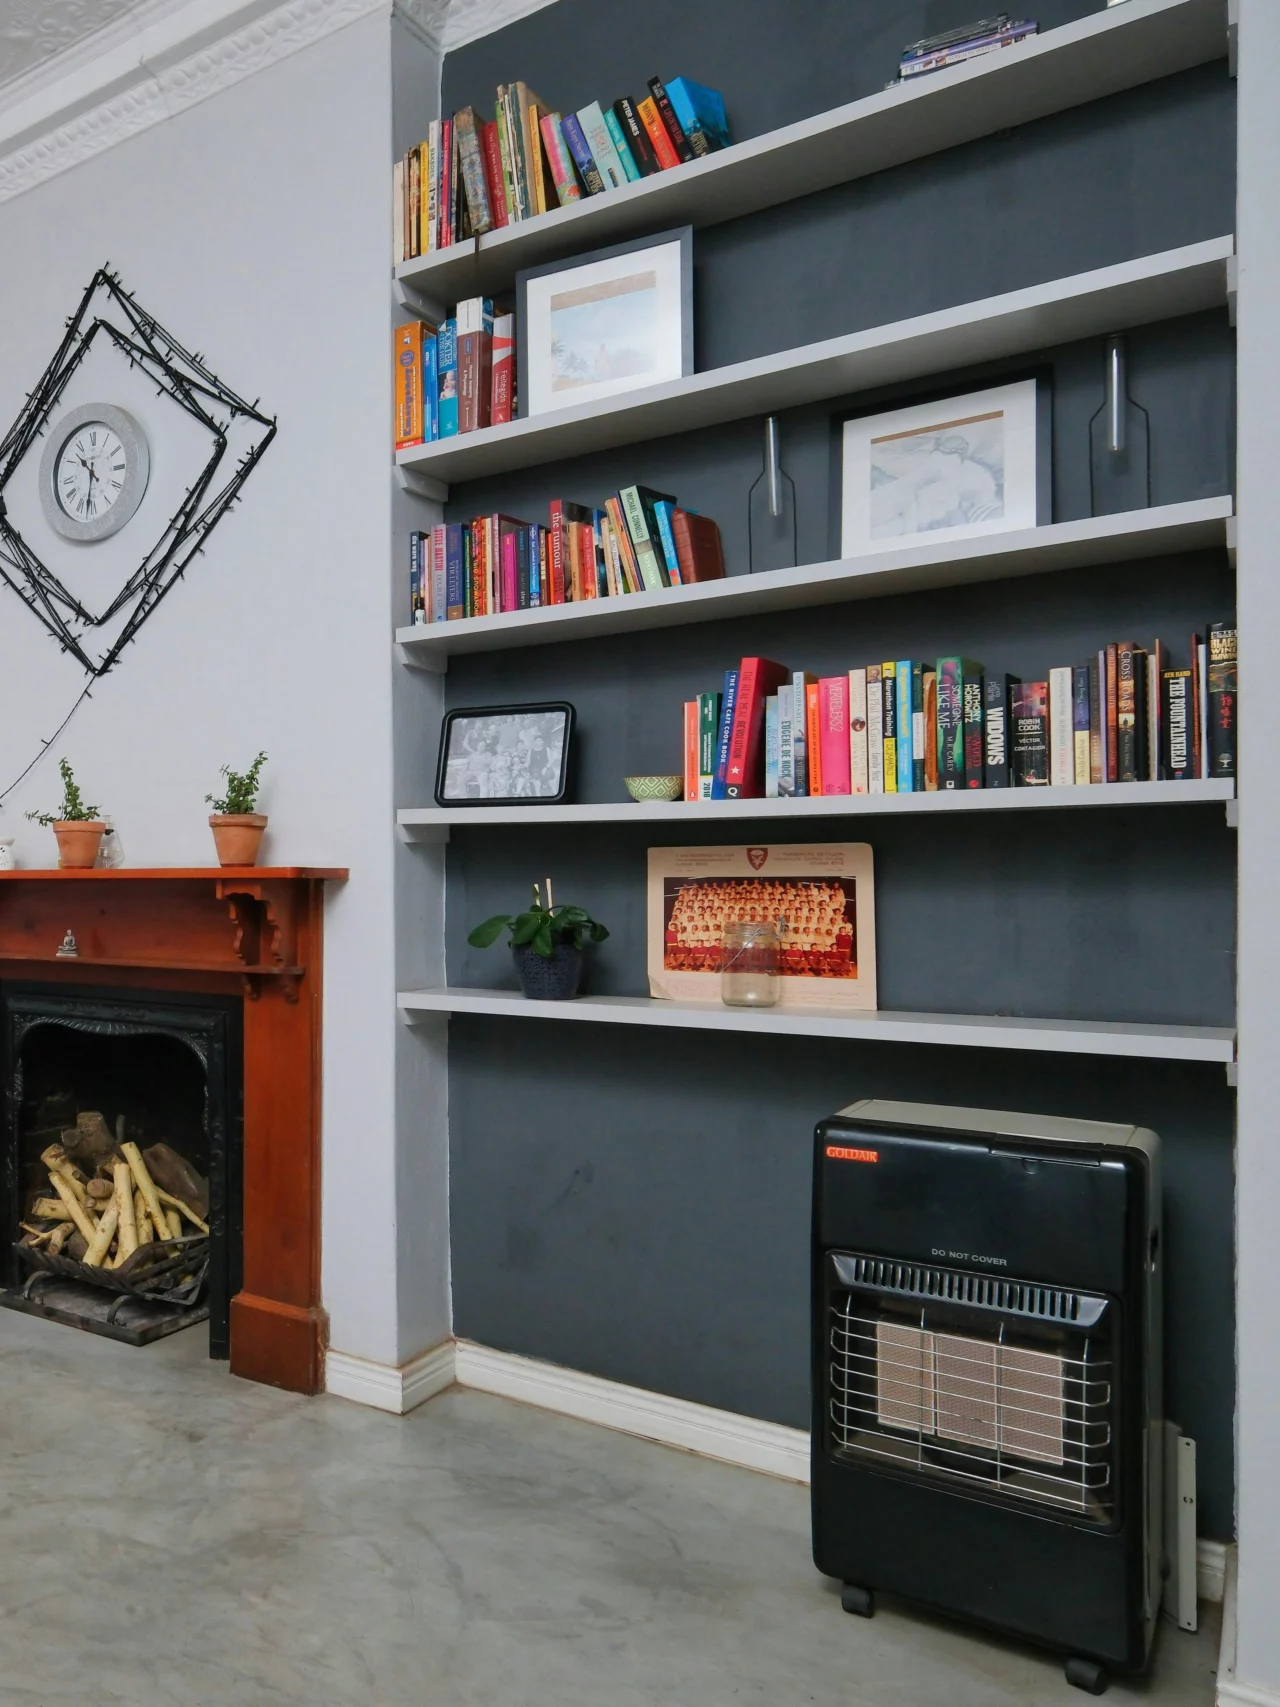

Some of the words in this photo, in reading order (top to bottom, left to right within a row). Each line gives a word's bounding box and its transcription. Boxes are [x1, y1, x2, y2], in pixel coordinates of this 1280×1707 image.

[621, 99, 632, 118] PETER
[627, 116, 639, 136] JAMES
[499, 370, 507, 403] Feitegids
[404, 368, 412, 436] Emergency
[553, 512, 561, 528] the
[625, 491, 636, 514] MICHAEL
[631, 514, 643, 539] CONNELLY
[435, 529, 443, 547] STEVE
[435, 548, 443, 570] MARTINI
[1121, 651, 1131, 679] CROSS
[742, 671, 753, 682] THE
[740, 684, 751, 701] REAL
[870, 686, 878, 696] Dr
[885, 680, 893, 710] Marathon
[938, 684, 949, 708] LIKE
[1122, 681, 1131, 711] ROADS
[1169, 678, 1185, 697] THE
[726, 688, 735, 708] RIVER
[870, 698, 880, 713] Phil
[952, 685, 960, 726] SOMEONE
[973, 684, 981, 722] ANTHONY
[724, 709, 732, 724] CAFE
[737, 702, 748, 721] MEAL
[938, 712, 949, 729] ME
[870, 716, 880, 749] McGraw
[885, 711, 893, 736] Training
[1170, 698, 1186, 768] FOUNTAINHEAD
[722, 726, 730, 743] COOK
[732, 720, 747, 759] REVOLUTION
[781, 721, 791, 747] EUGENE
[987, 707, 1004, 765] WIDOWS
[719, 745, 728, 764] BOOK
[782, 750, 791, 758] DE
[871, 752, 880, 769] family
[782, 760, 791, 778] KOCK
[872, 771, 880, 781] first
[702, 782, 712, 798] 2018
[826, 1146, 878, 1162] GOLDAIR
[931, 1248, 946, 1257] DO
[949, 1249, 970, 1260] NOT
[971, 1255, 1007, 1267] COVER
